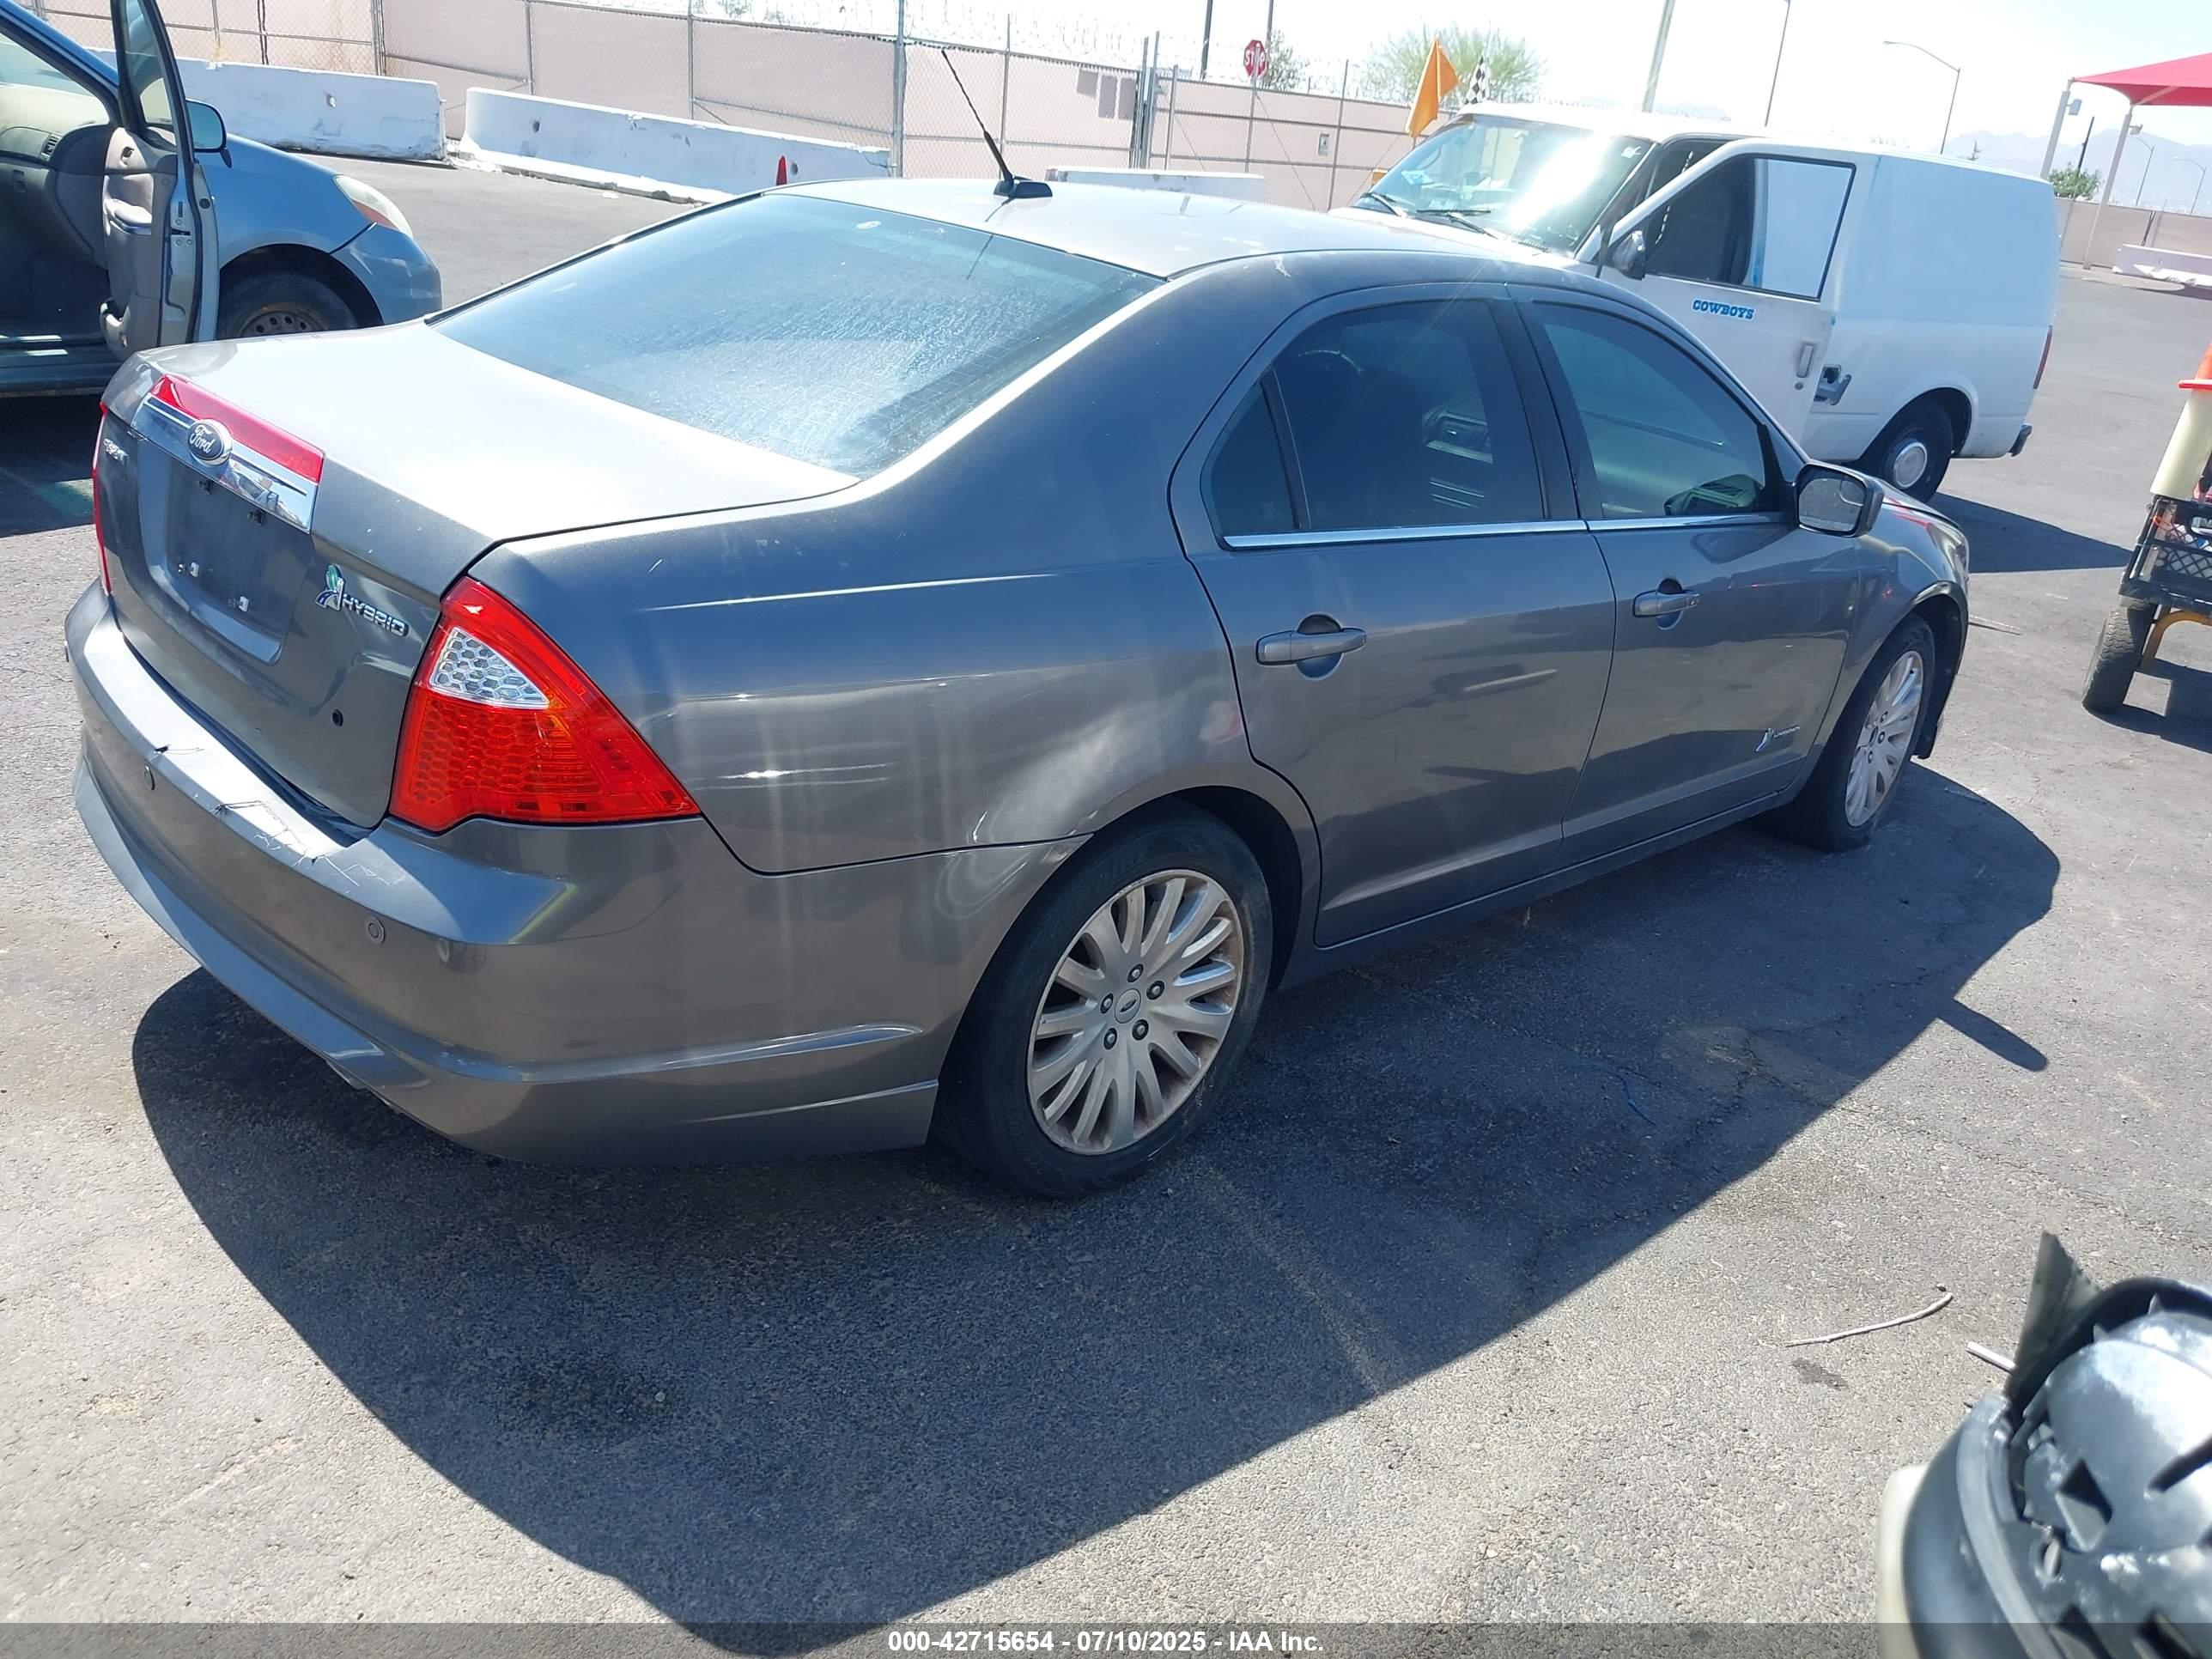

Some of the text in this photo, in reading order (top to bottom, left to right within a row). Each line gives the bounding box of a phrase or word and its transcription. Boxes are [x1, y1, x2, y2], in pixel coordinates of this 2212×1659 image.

[1245, 50, 1266, 68] STP
[1692, 299, 1755, 320] COWBOYS
[189, 424, 216, 454] Ford
[343, 592, 407, 636] HYBRID
